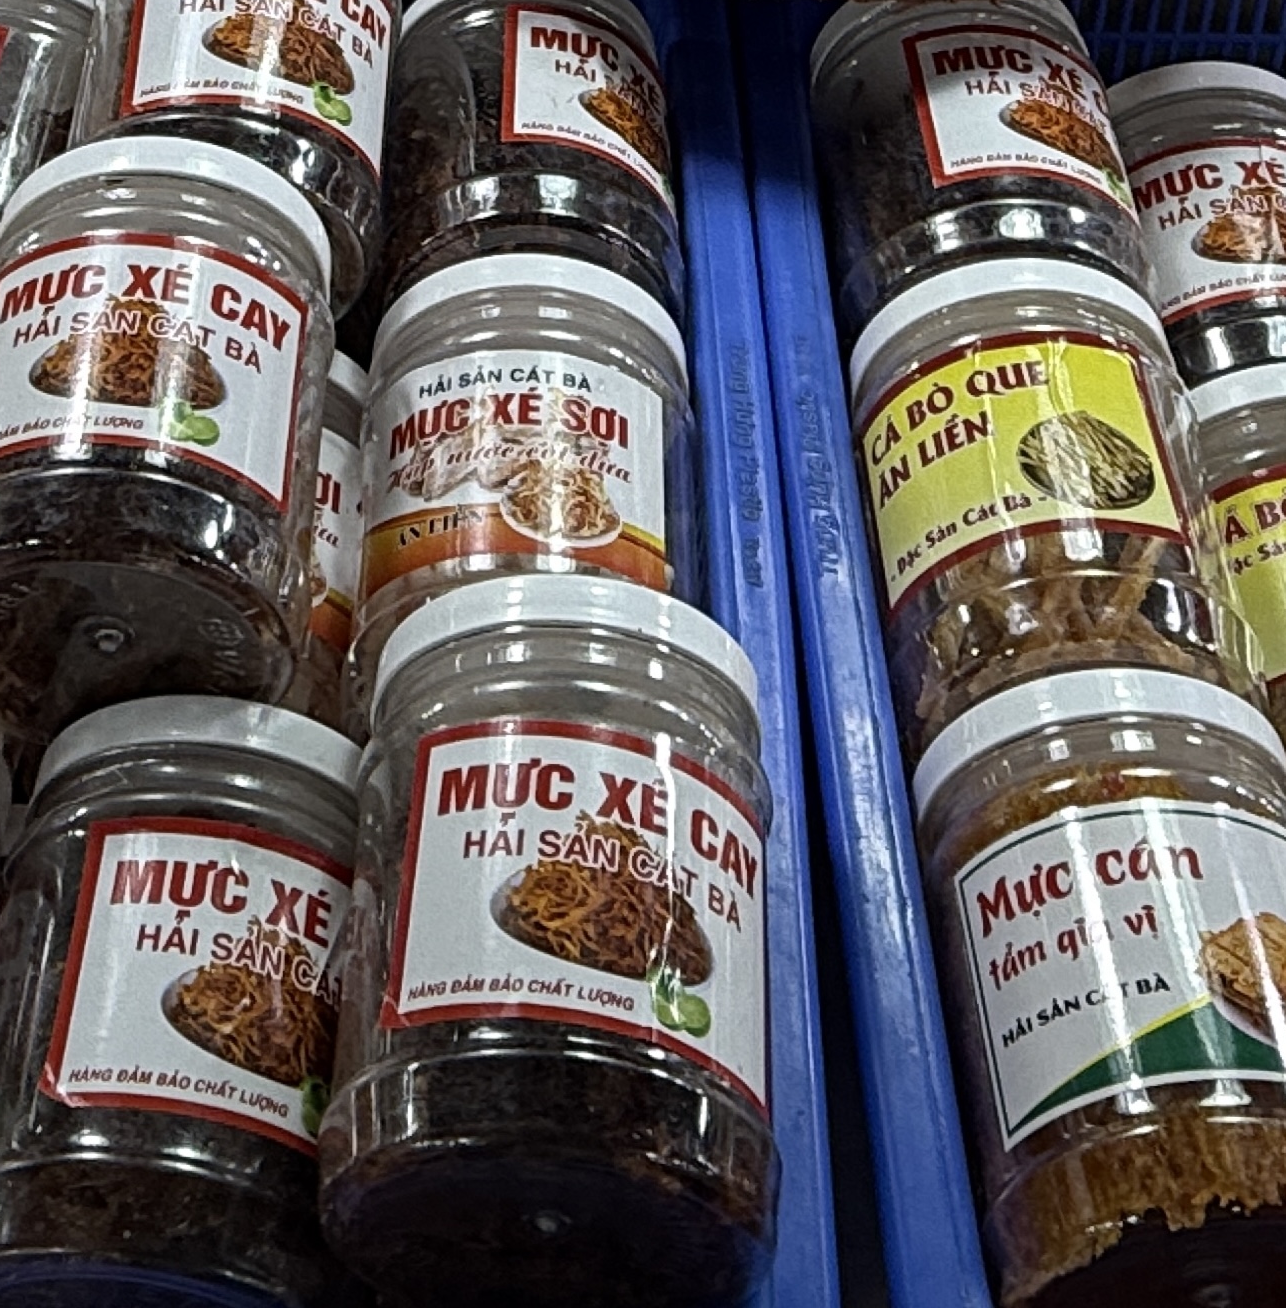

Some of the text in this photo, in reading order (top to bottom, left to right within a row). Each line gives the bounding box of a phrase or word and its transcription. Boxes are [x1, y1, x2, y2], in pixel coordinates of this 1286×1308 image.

[300, 7, 345, 43] CÁT
[352, 36, 373, 69] BÀ
[531, 27, 619, 72] MỰC
[555, 56, 596, 83] HẢI
[932, 45, 1033, 76] MỰC
[965, 71, 1011, 96] HẢI
[1134, 163, 1224, 213] MỰC
[1159, 196, 1203, 231] HẢI
[0, 263, 292, 352] MỰC XÉ CAY
[13, 295, 262, 375] HẢI SẢN CÁT BÀ
[419, 365, 592, 400] HẢI SẢN CÁT BÀ
[871, 359, 1051, 466] CÁ BÒ QUE
[389, 387, 629, 461] MỰC XÉ SỢI
[878, 409, 993, 510] ĂN LIỀN
[895, 548, 924, 576] Đặc
[924, 520, 958, 549] Sản
[436, 758, 759, 898] MỰC XÉ CAY
[110, 859, 333, 948] MỰC XÉ
[463, 812, 742, 933] HẢI SẢN CÁT BÀ
[976, 837, 1204, 938] Mực cán
[135, 911, 285, 977] HẢI SẢN
[408, 972, 635, 1012] HÀNG ĐẢM BẢO CHẤT LƯỢNG
[1001, 972, 1171, 1048] HẢI SẢN BÀ
[68, 1065, 289, 1118] HÀNG ĐẢM BẢO CHẤT LƯỢNG
